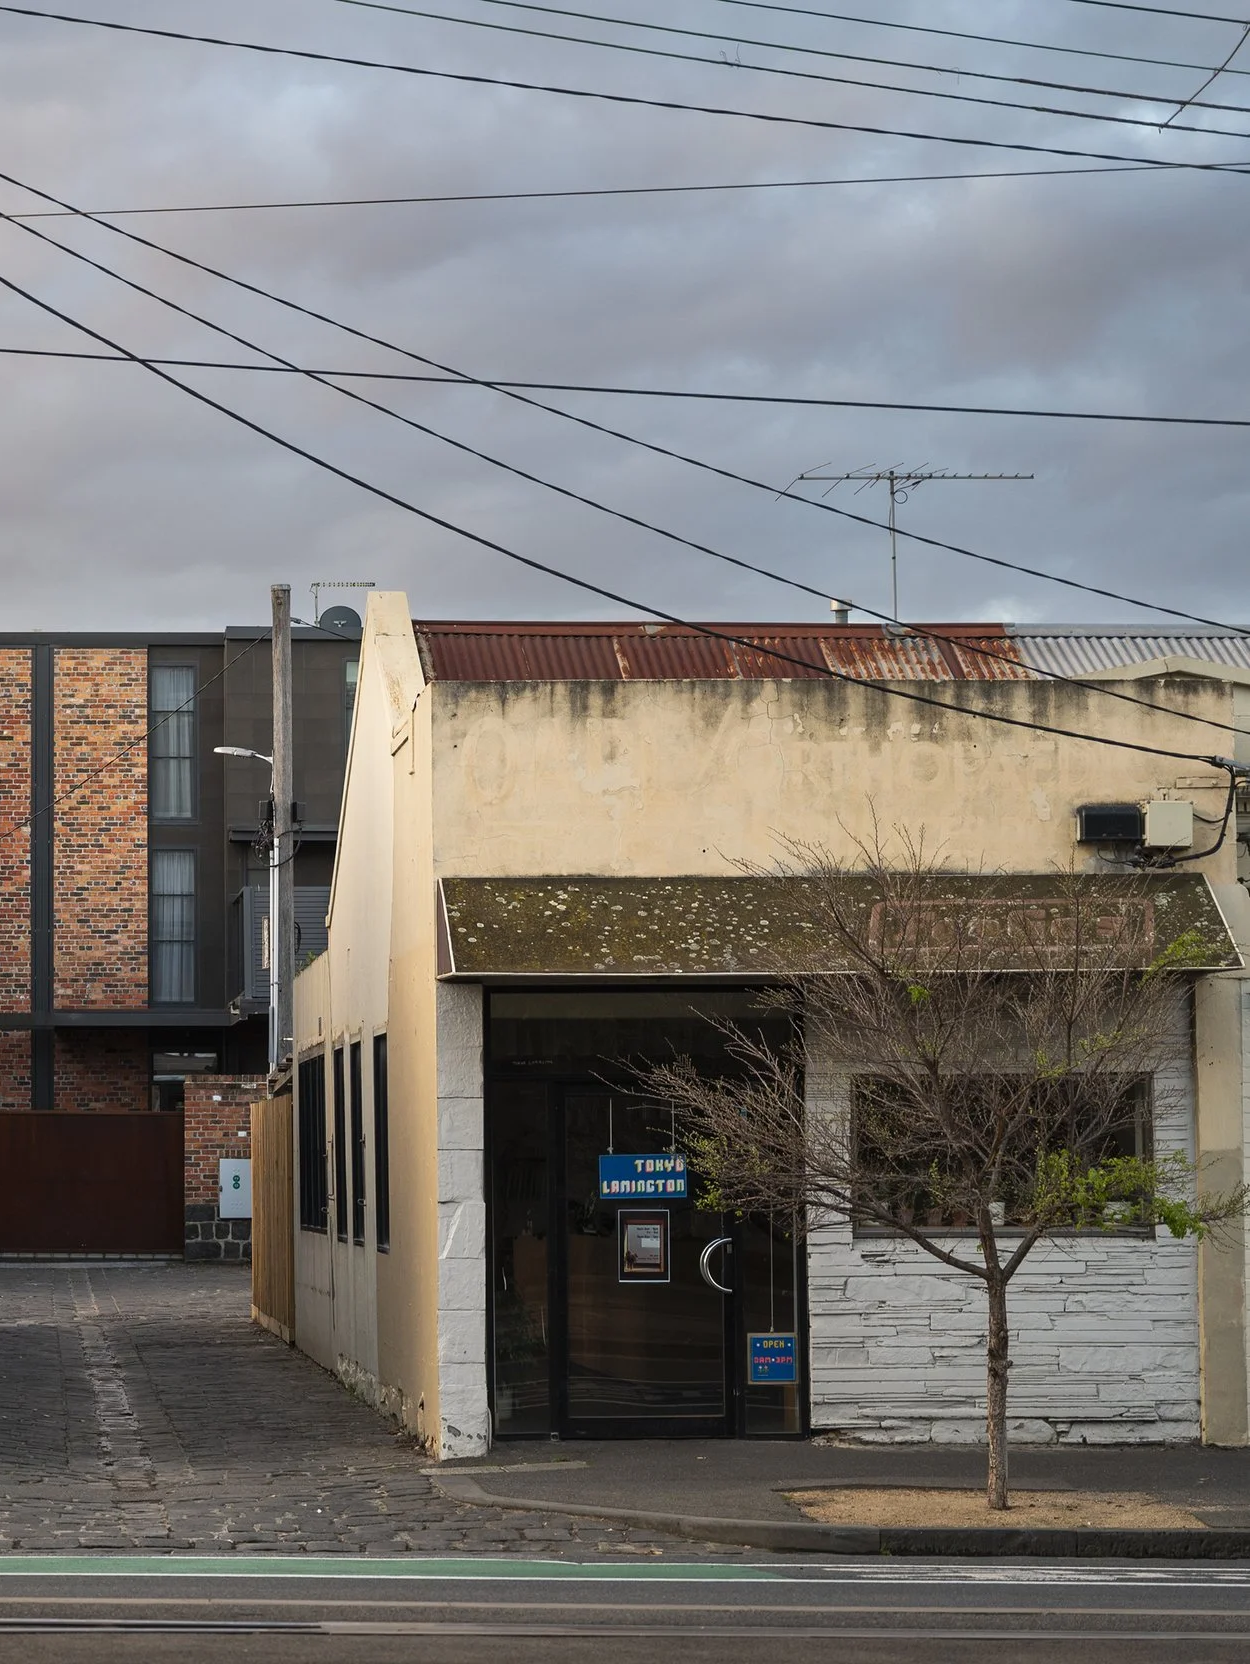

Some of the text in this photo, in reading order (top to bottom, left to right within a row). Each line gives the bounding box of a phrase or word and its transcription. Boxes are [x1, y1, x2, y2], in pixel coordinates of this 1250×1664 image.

[634, 1159, 684, 1173] TOKYO
[602, 1179, 685, 1194] LAMINGTON
[763, 1340, 785, 1349] OPEN
